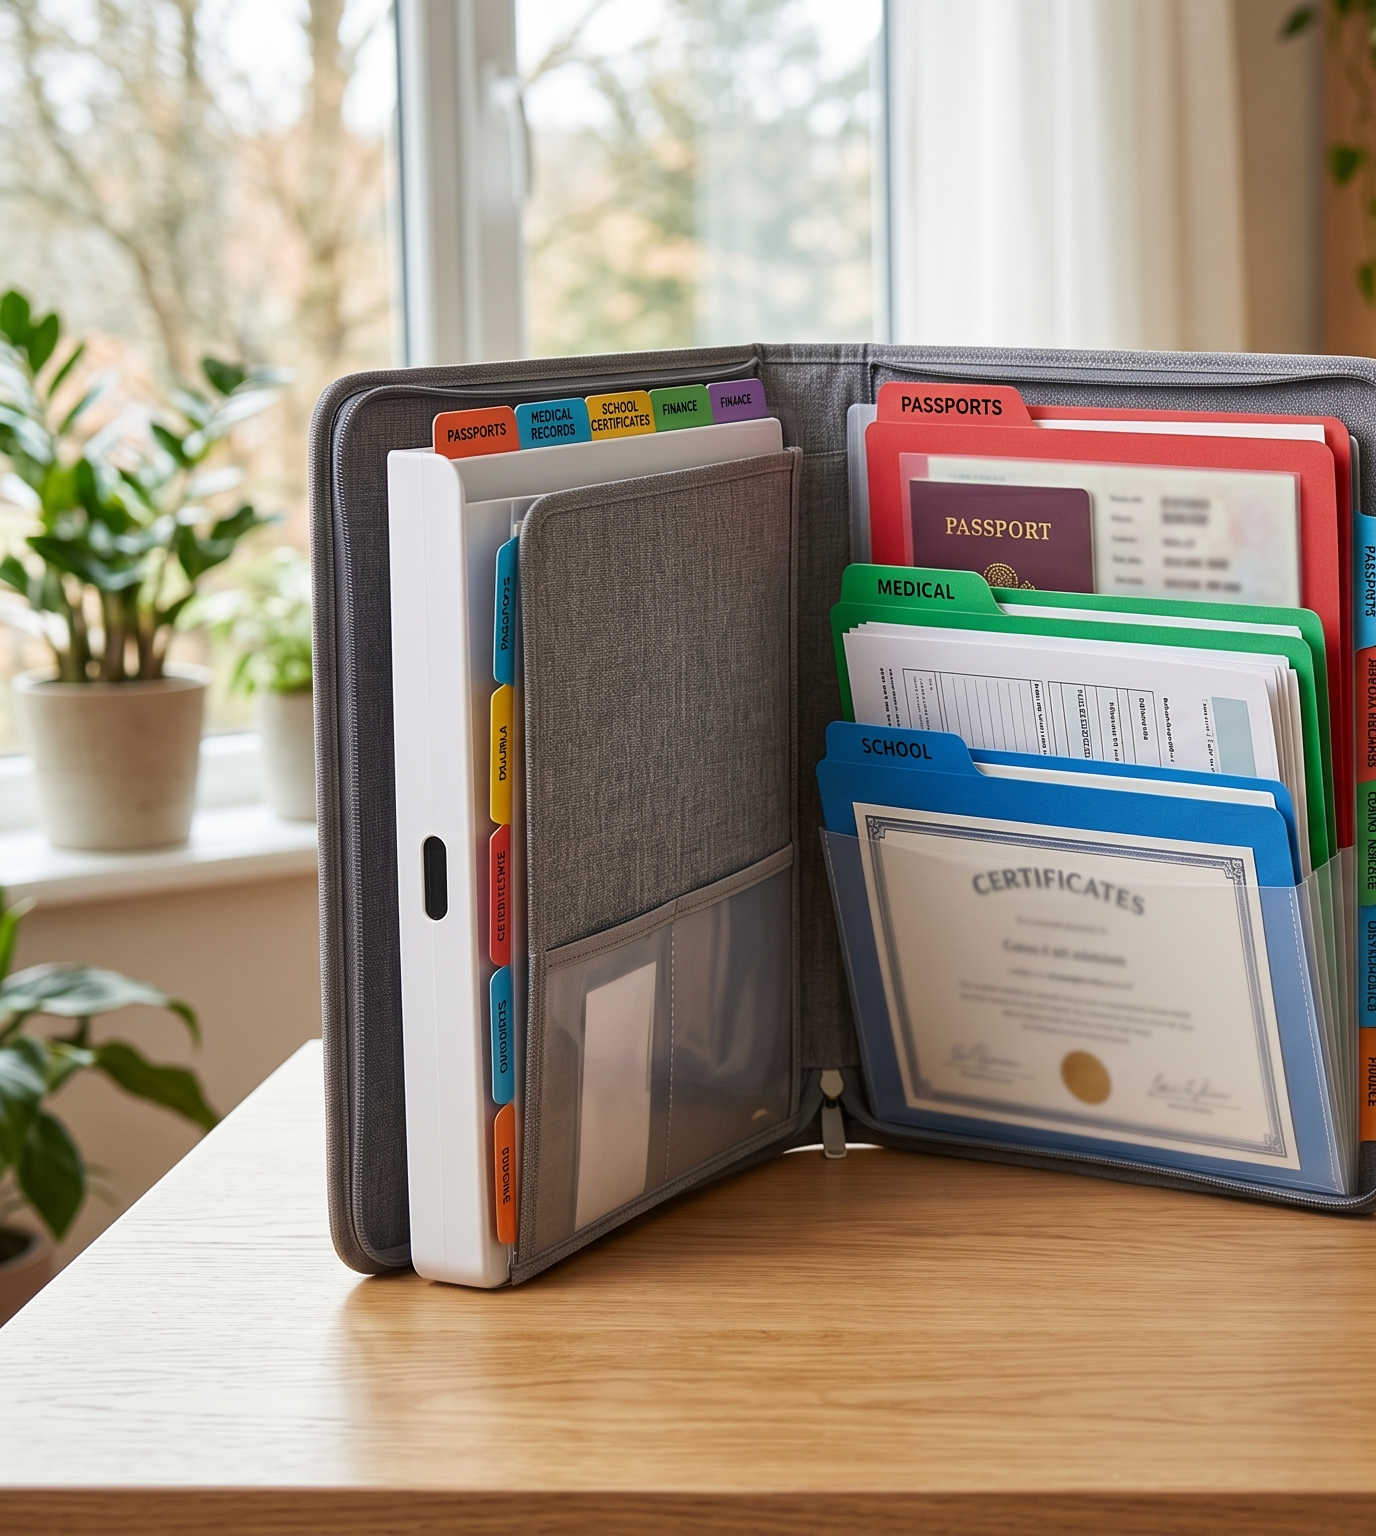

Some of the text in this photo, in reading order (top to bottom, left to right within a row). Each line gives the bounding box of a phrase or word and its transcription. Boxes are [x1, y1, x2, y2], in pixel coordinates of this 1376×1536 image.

[530, 407, 573, 424] MEDICAL
[601, 400, 639, 415] SCHOOL
[662, 399, 698, 416] FINANCE
[900, 396, 1003, 416] PASSPORTS
[446, 422, 507, 443] PASSPORTS
[530, 422, 576, 440] RECORDS
[590, 414, 651, 432] CERTIFICATES
[944, 517, 1052, 541] PASSPORT
[876, 578, 956, 601] MEDICAL
[860, 737, 933, 761] SCHOOL
[971, 866, 1147, 917] CERTIFICATES
